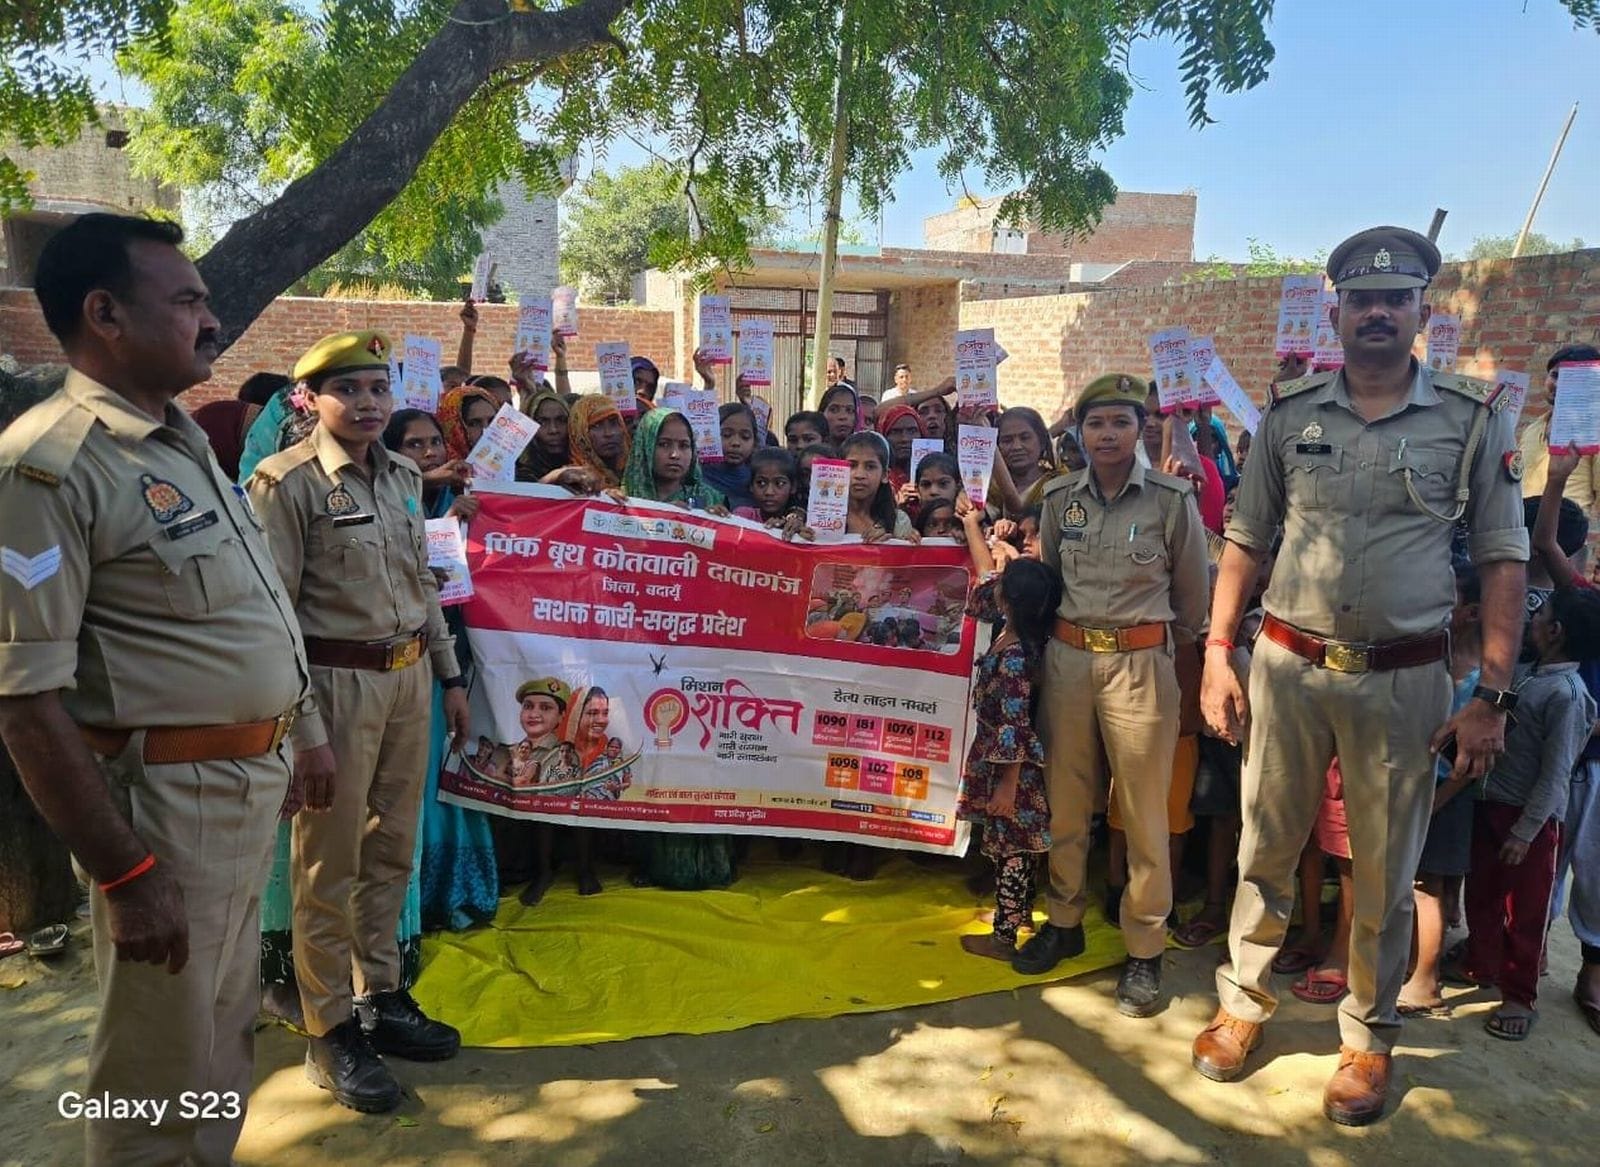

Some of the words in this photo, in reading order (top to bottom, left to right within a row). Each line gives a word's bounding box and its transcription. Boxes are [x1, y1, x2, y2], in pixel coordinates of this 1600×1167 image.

[484, 532, 541, 556] पिंक
[547, 540, 586, 570] बूथ
[593, 543, 700, 577] कोतवाली
[707, 561, 802, 595] दातागंज
[532, 597, 590, 624] सशक्त
[594, 601, 699, 641] नारी-समृद्ध
[701, 610, 746, 637] प्रदेश
[680, 676, 724, 693] मिशन
[863, 694, 896, 707] लाइन
[691, 678, 804, 751] शक्ति
[817, 714, 847, 727] 1090
[856, 719, 875, 730] 181
[887, 722, 915, 736] 1076
[925, 729, 945, 741] 112
[830, 757, 859, 770] 1098
[868, 762, 889, 775] 102
[902, 767, 923, 780] 108
